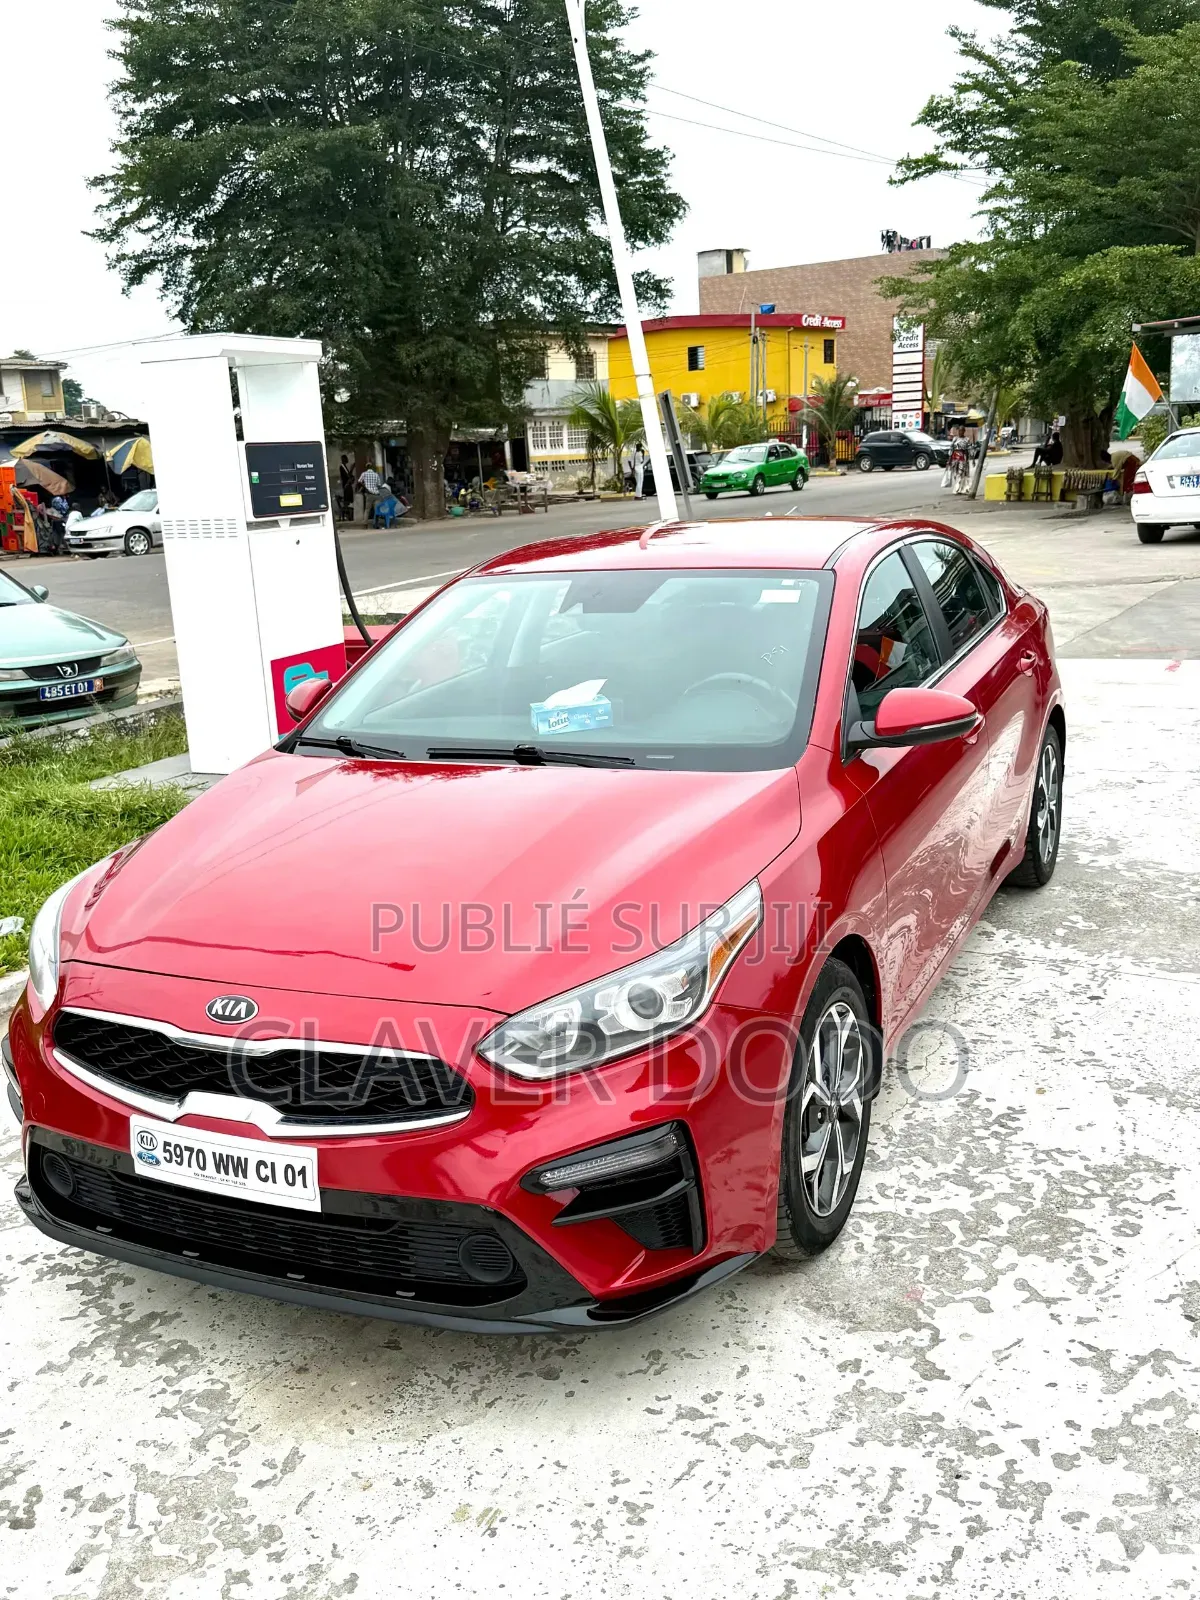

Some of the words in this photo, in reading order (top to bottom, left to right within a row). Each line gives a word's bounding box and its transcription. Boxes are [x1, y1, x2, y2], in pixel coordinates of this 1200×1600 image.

[802, 314, 822, 327] Credit
[77, 681, 89, 693] 01
[211, 998, 248, 1019] KIA
[138, 1135, 156, 1149] KIA
[141, 1153, 157, 1165] Ford
[162, 1140, 207, 1171] 5970
[212, 1151, 249, 1179] WW
[255, 1160, 278, 1184] CI
[284, 1163, 308, 1189] 01
